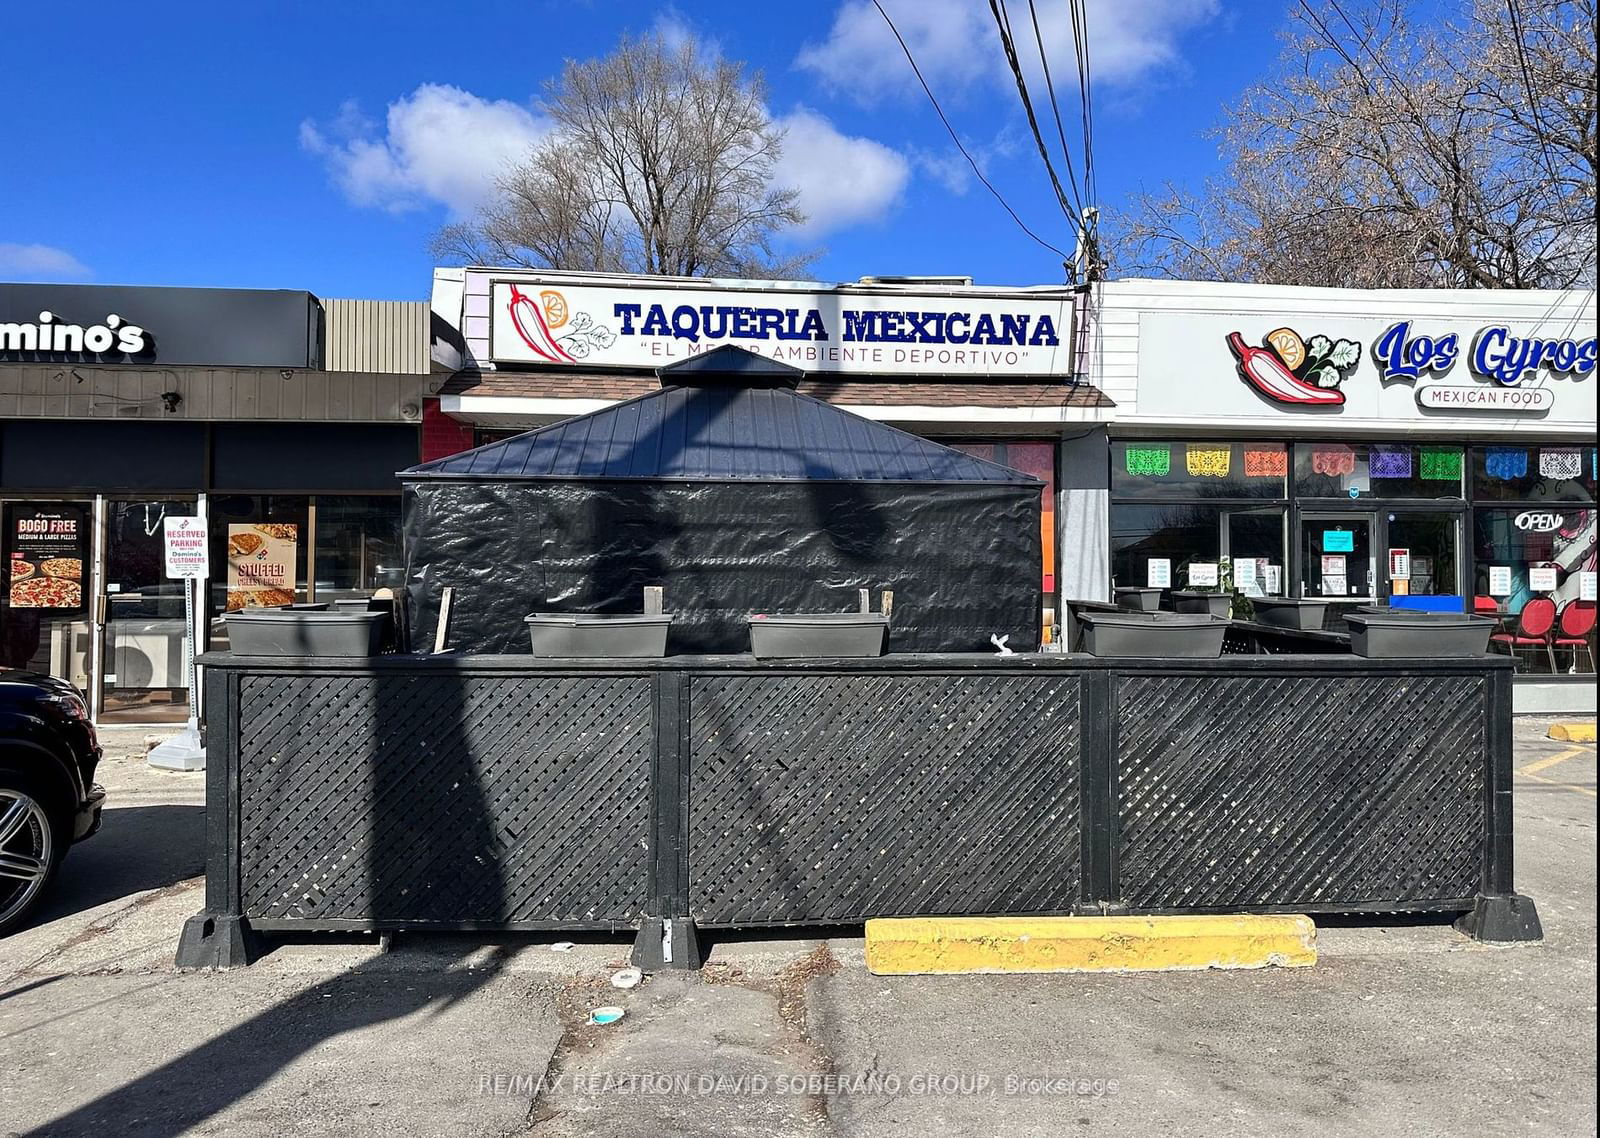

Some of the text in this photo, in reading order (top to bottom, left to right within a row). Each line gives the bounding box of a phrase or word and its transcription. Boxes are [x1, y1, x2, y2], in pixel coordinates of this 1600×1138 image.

[614, 303, 1060, 346] TAQUERIA MEXICANA
[773, 346, 882, 361] AMBIENTE
[895, 350, 1029, 365] DEPORTIVO"
[1377, 321, 1597, 384] Los Gyros
[1432, 390, 1543, 404] MEXICAN FOOD
[18, 519, 77, 533] BOGO FREE
[1518, 513, 1560, 530] OPEN
[167, 530, 205, 538] RESERVED
[238, 563, 286, 577] STUFFED
